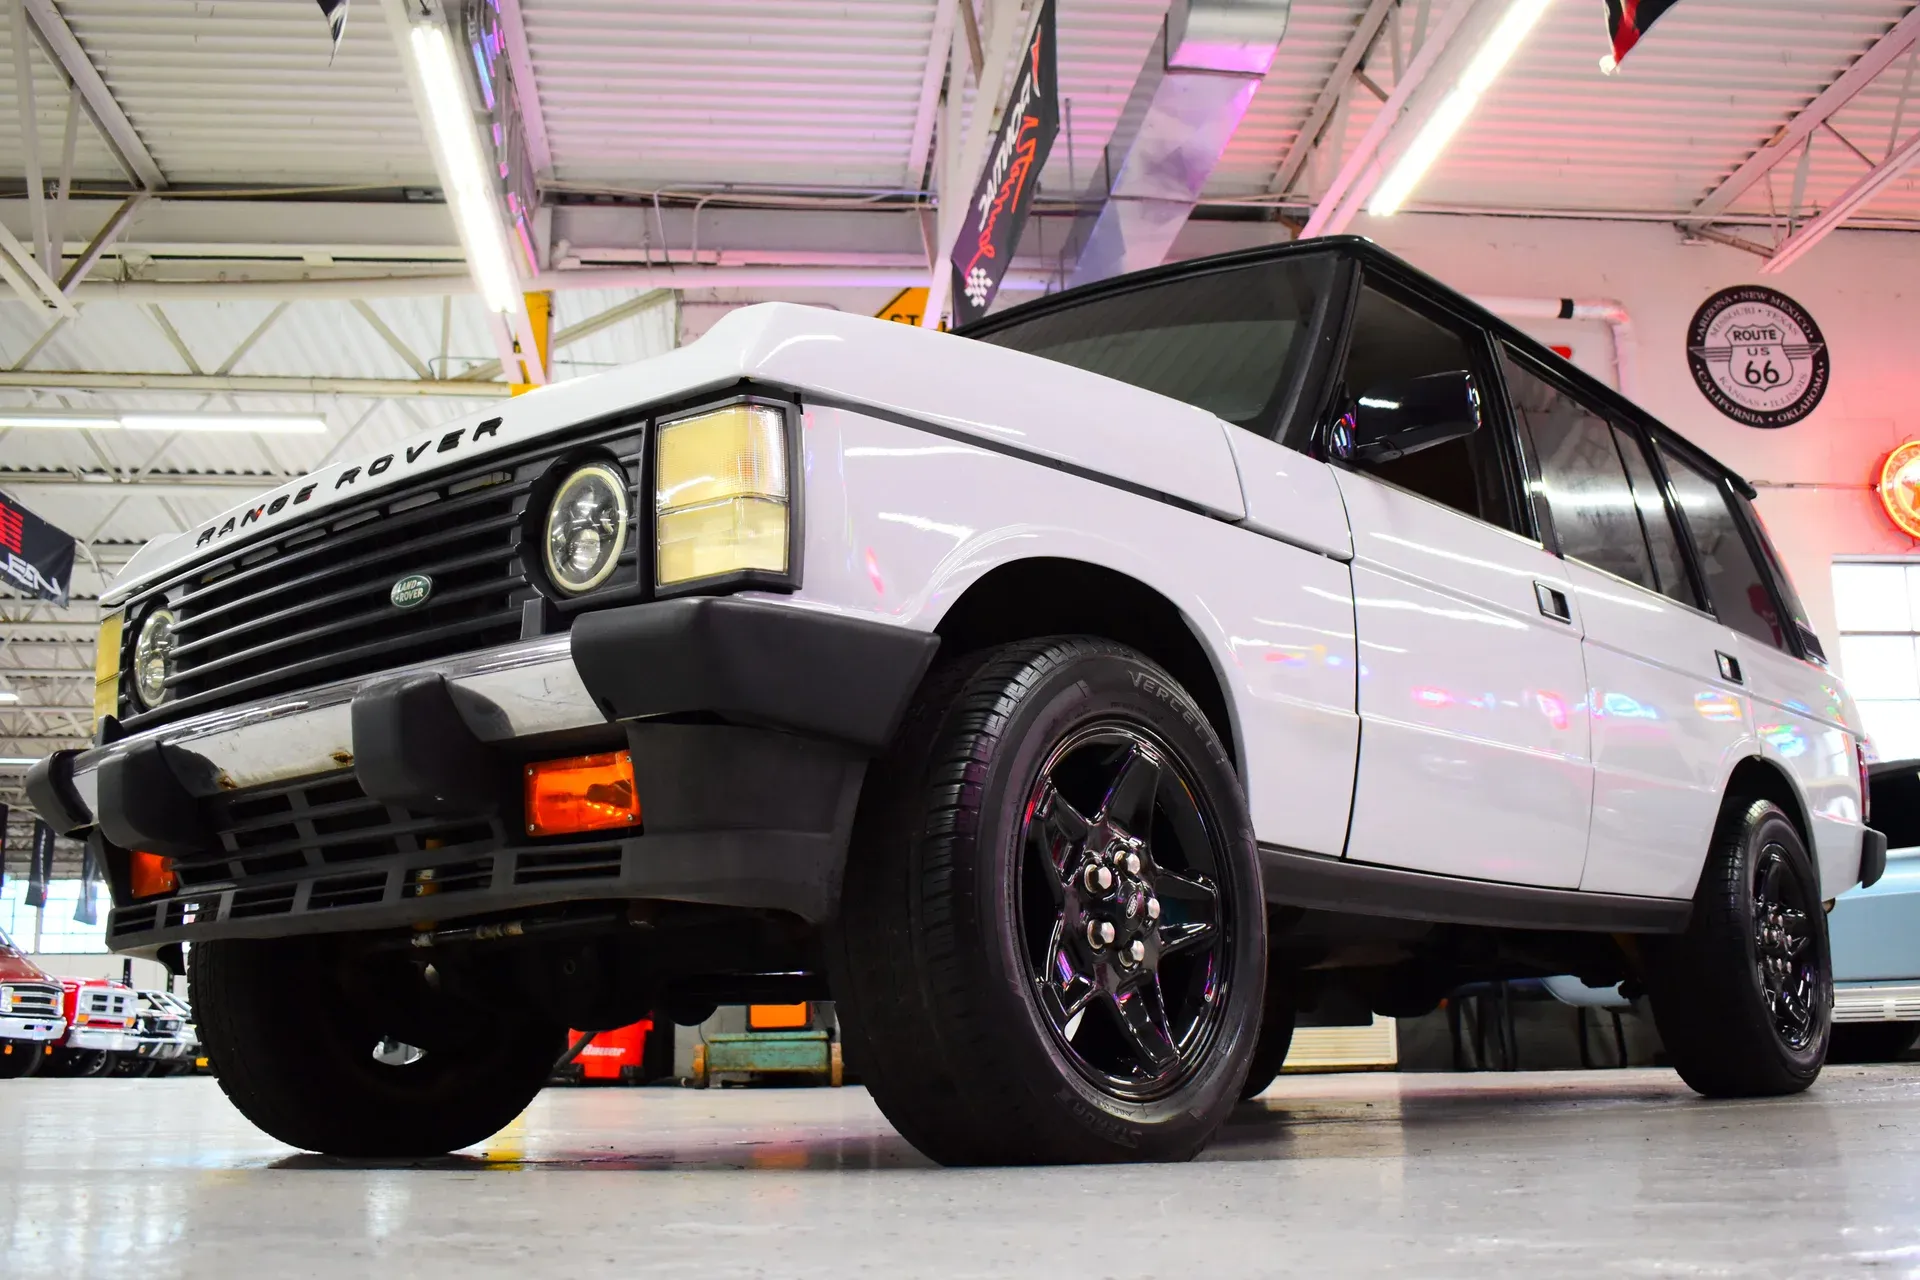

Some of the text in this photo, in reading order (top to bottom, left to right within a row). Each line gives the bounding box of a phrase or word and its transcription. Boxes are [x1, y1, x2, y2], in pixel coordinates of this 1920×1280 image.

[1697, 291, 1812, 337] ARIZONA NEW MEXICO
[1710, 306, 1799, 337] MISSOURI TEXAS
[1733, 329, 1777, 341] ROUTE
[1747, 347, 1770, 356] US
[1745, 360, 1780, 384] 66
[1698, 367, 1825, 424] CALIFORNIA OKLAHOMA
[1719, 373, 1808, 408] KANSAS ILLINOIS
[194, 416, 504, 548] RANGE ROVER
[397, 579, 418, 593] LAND
[399, 587, 424, 603] ROVER
[1127, 670, 1225, 766] VERCELLI
